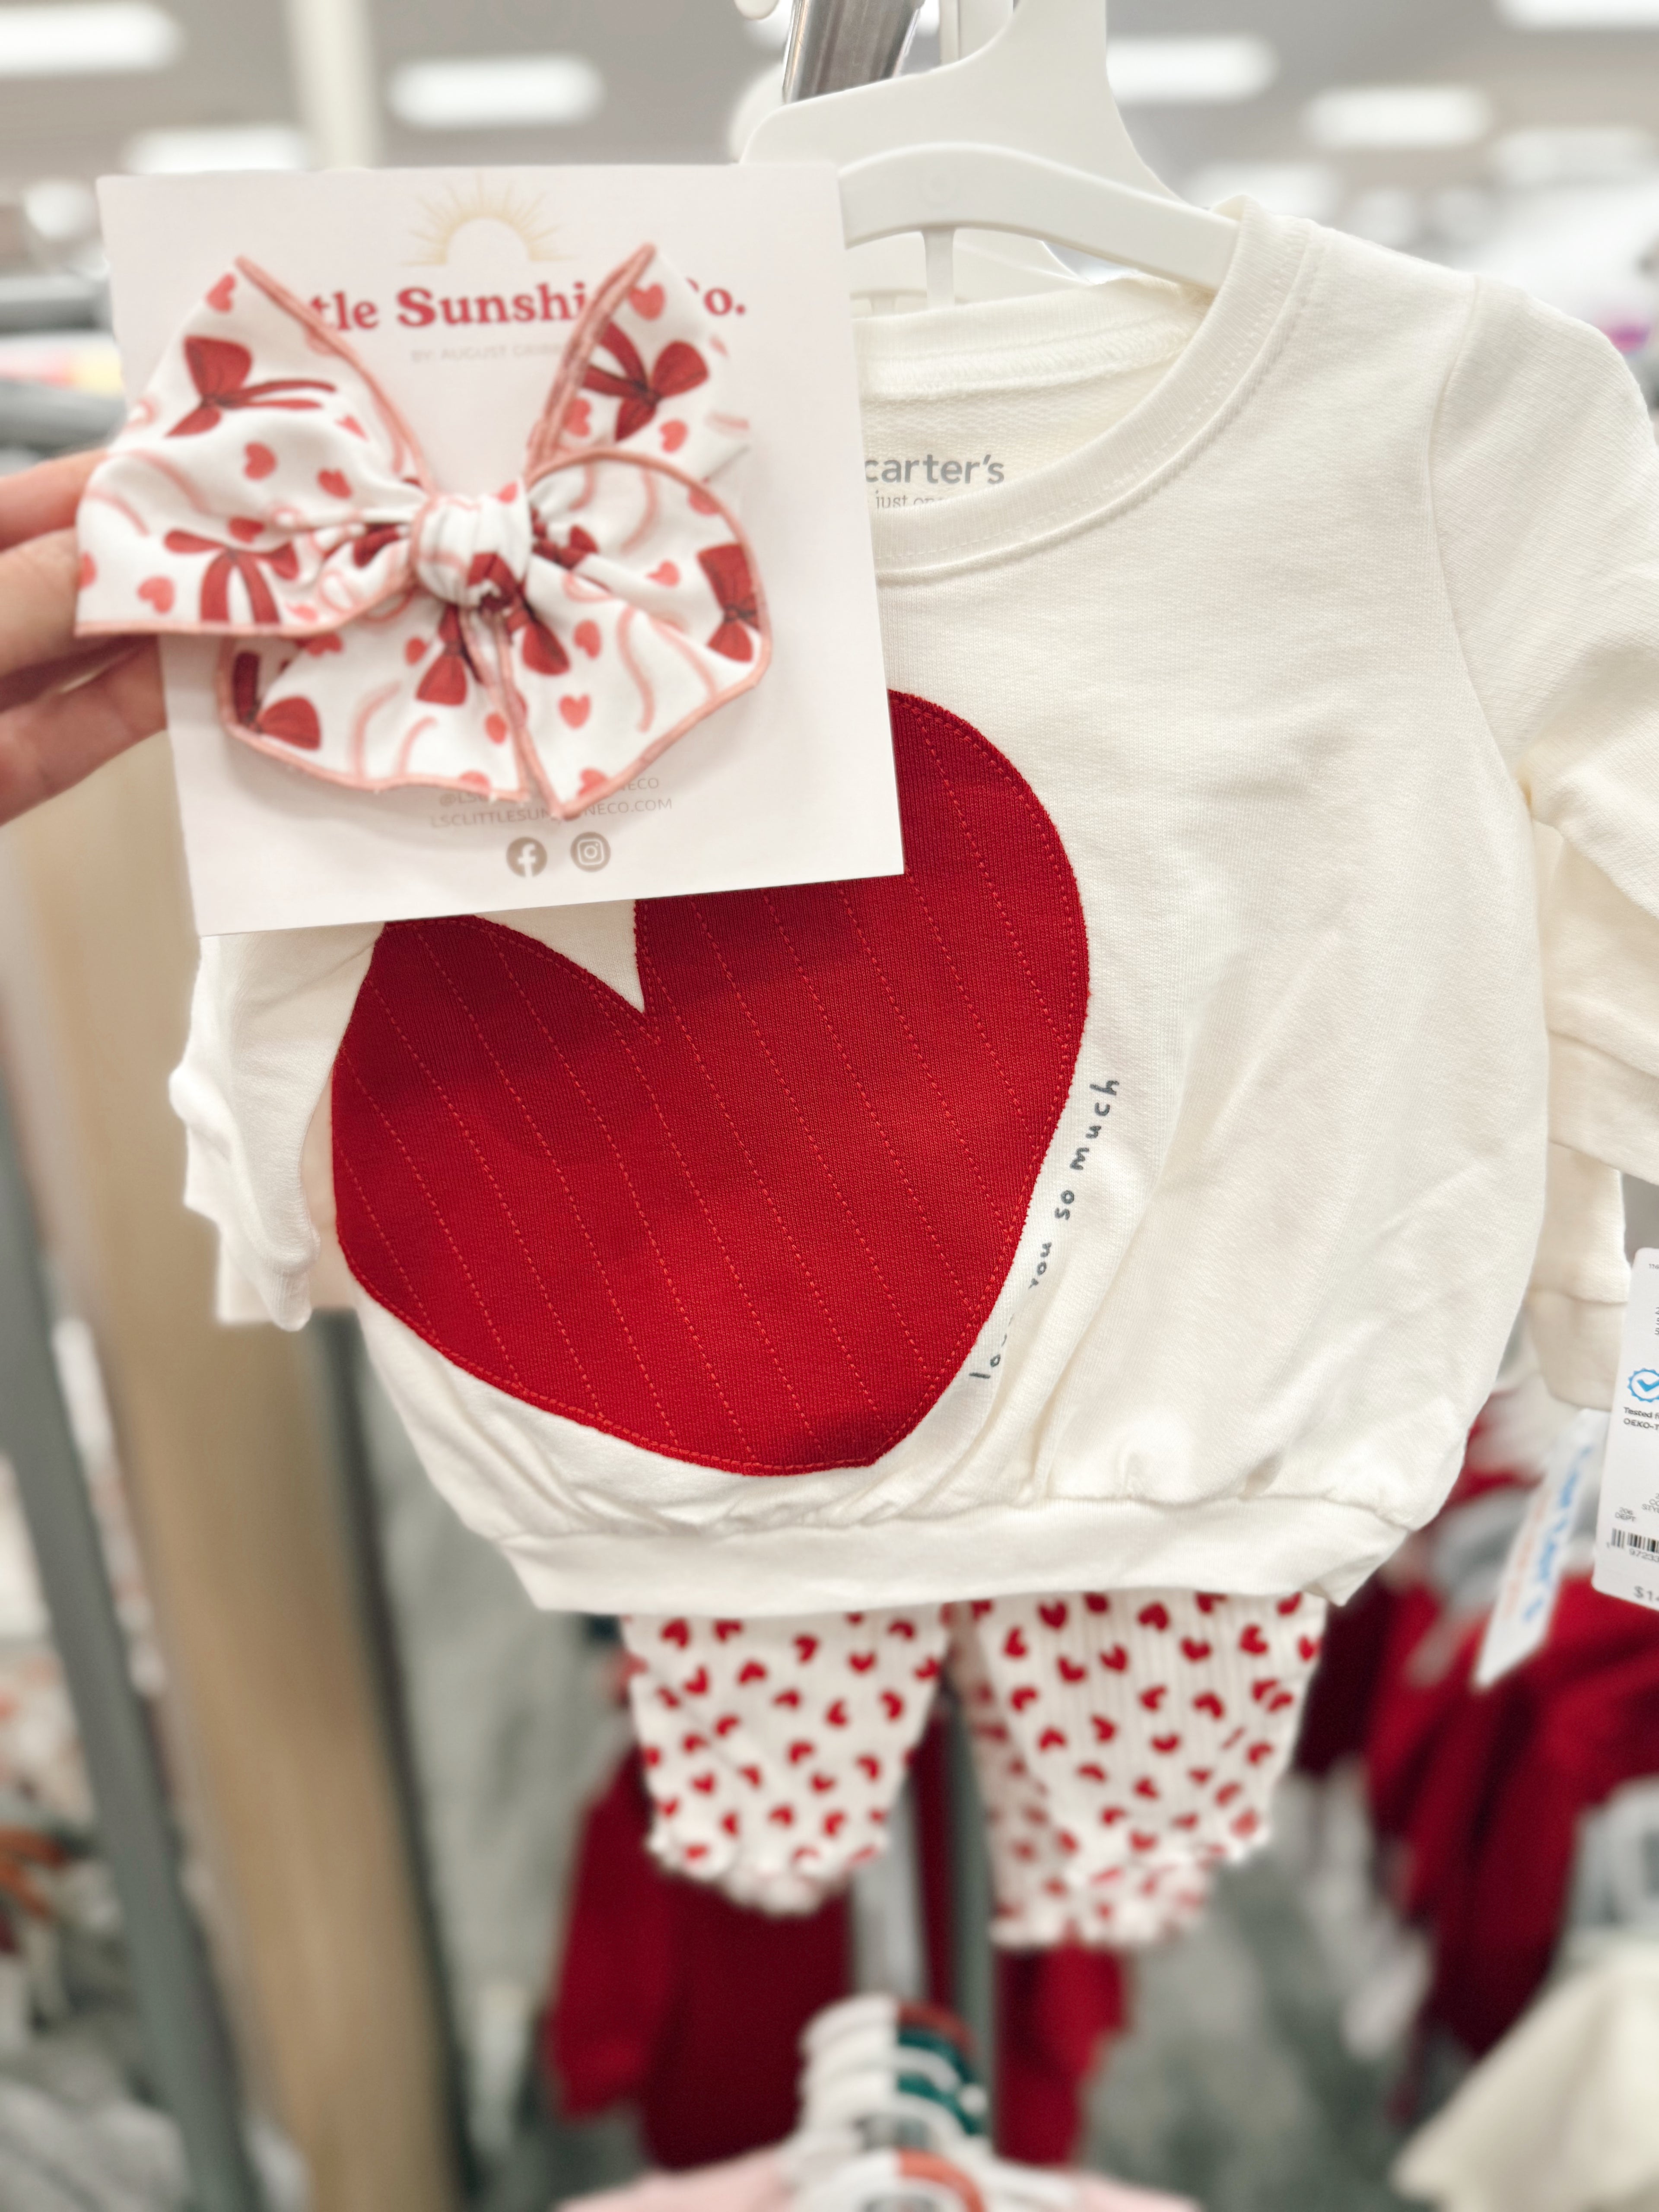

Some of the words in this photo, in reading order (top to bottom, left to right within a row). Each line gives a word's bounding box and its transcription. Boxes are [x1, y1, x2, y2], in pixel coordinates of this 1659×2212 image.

[309, 291, 379, 331] tle
[397, 282, 585, 327] Sunshi
[686, 277, 746, 316] o.
[864, 454, 1005, 484] carter's
[875, 490, 908, 509] just
[431, 798, 672, 828] LSCLITTLESUNNECO.COM
[1055, 1189, 1075, 1220] so
[1070, 1079, 1120, 1170] much
[1624, 1407, 1653, 1418] Tested
[1615, 1512, 1636, 1521] DEPT
